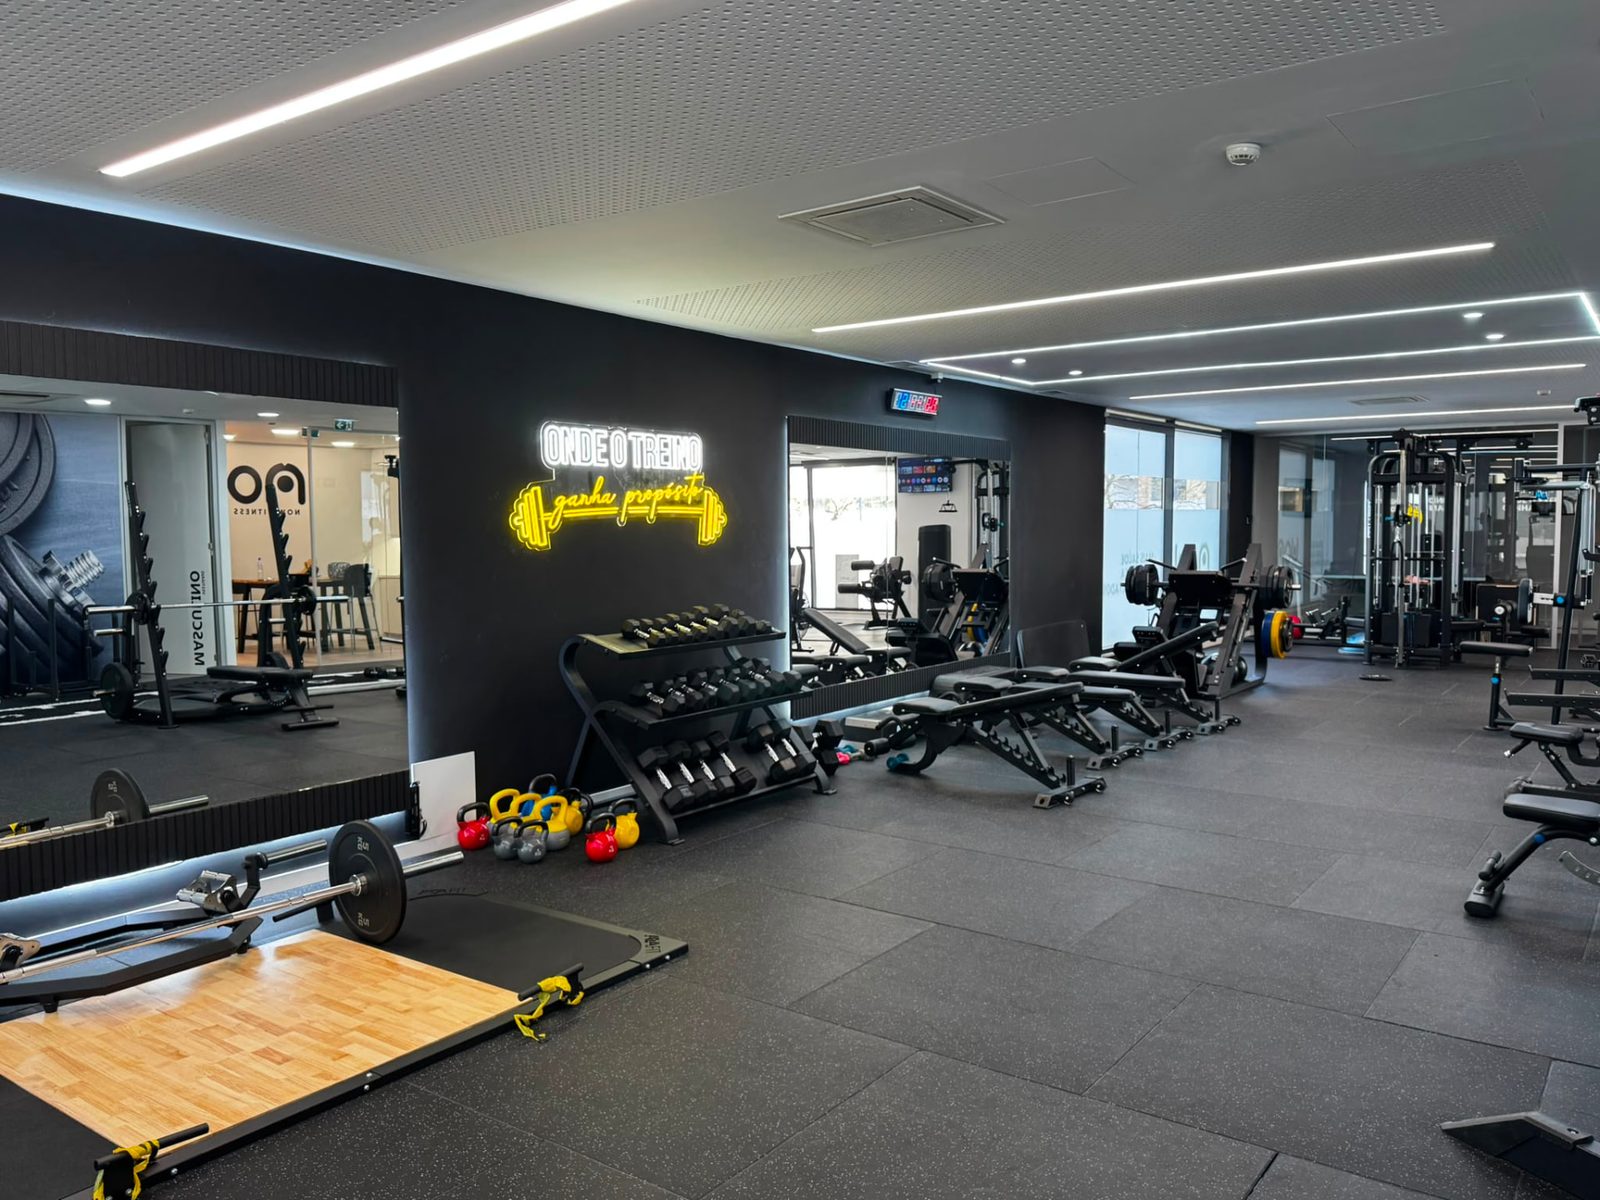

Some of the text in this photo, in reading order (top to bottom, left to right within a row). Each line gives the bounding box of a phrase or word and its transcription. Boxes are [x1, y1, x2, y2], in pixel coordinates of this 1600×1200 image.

[543, 424, 703, 471] ONDE O TREINO
[548, 471, 704, 529] ganha propósito
